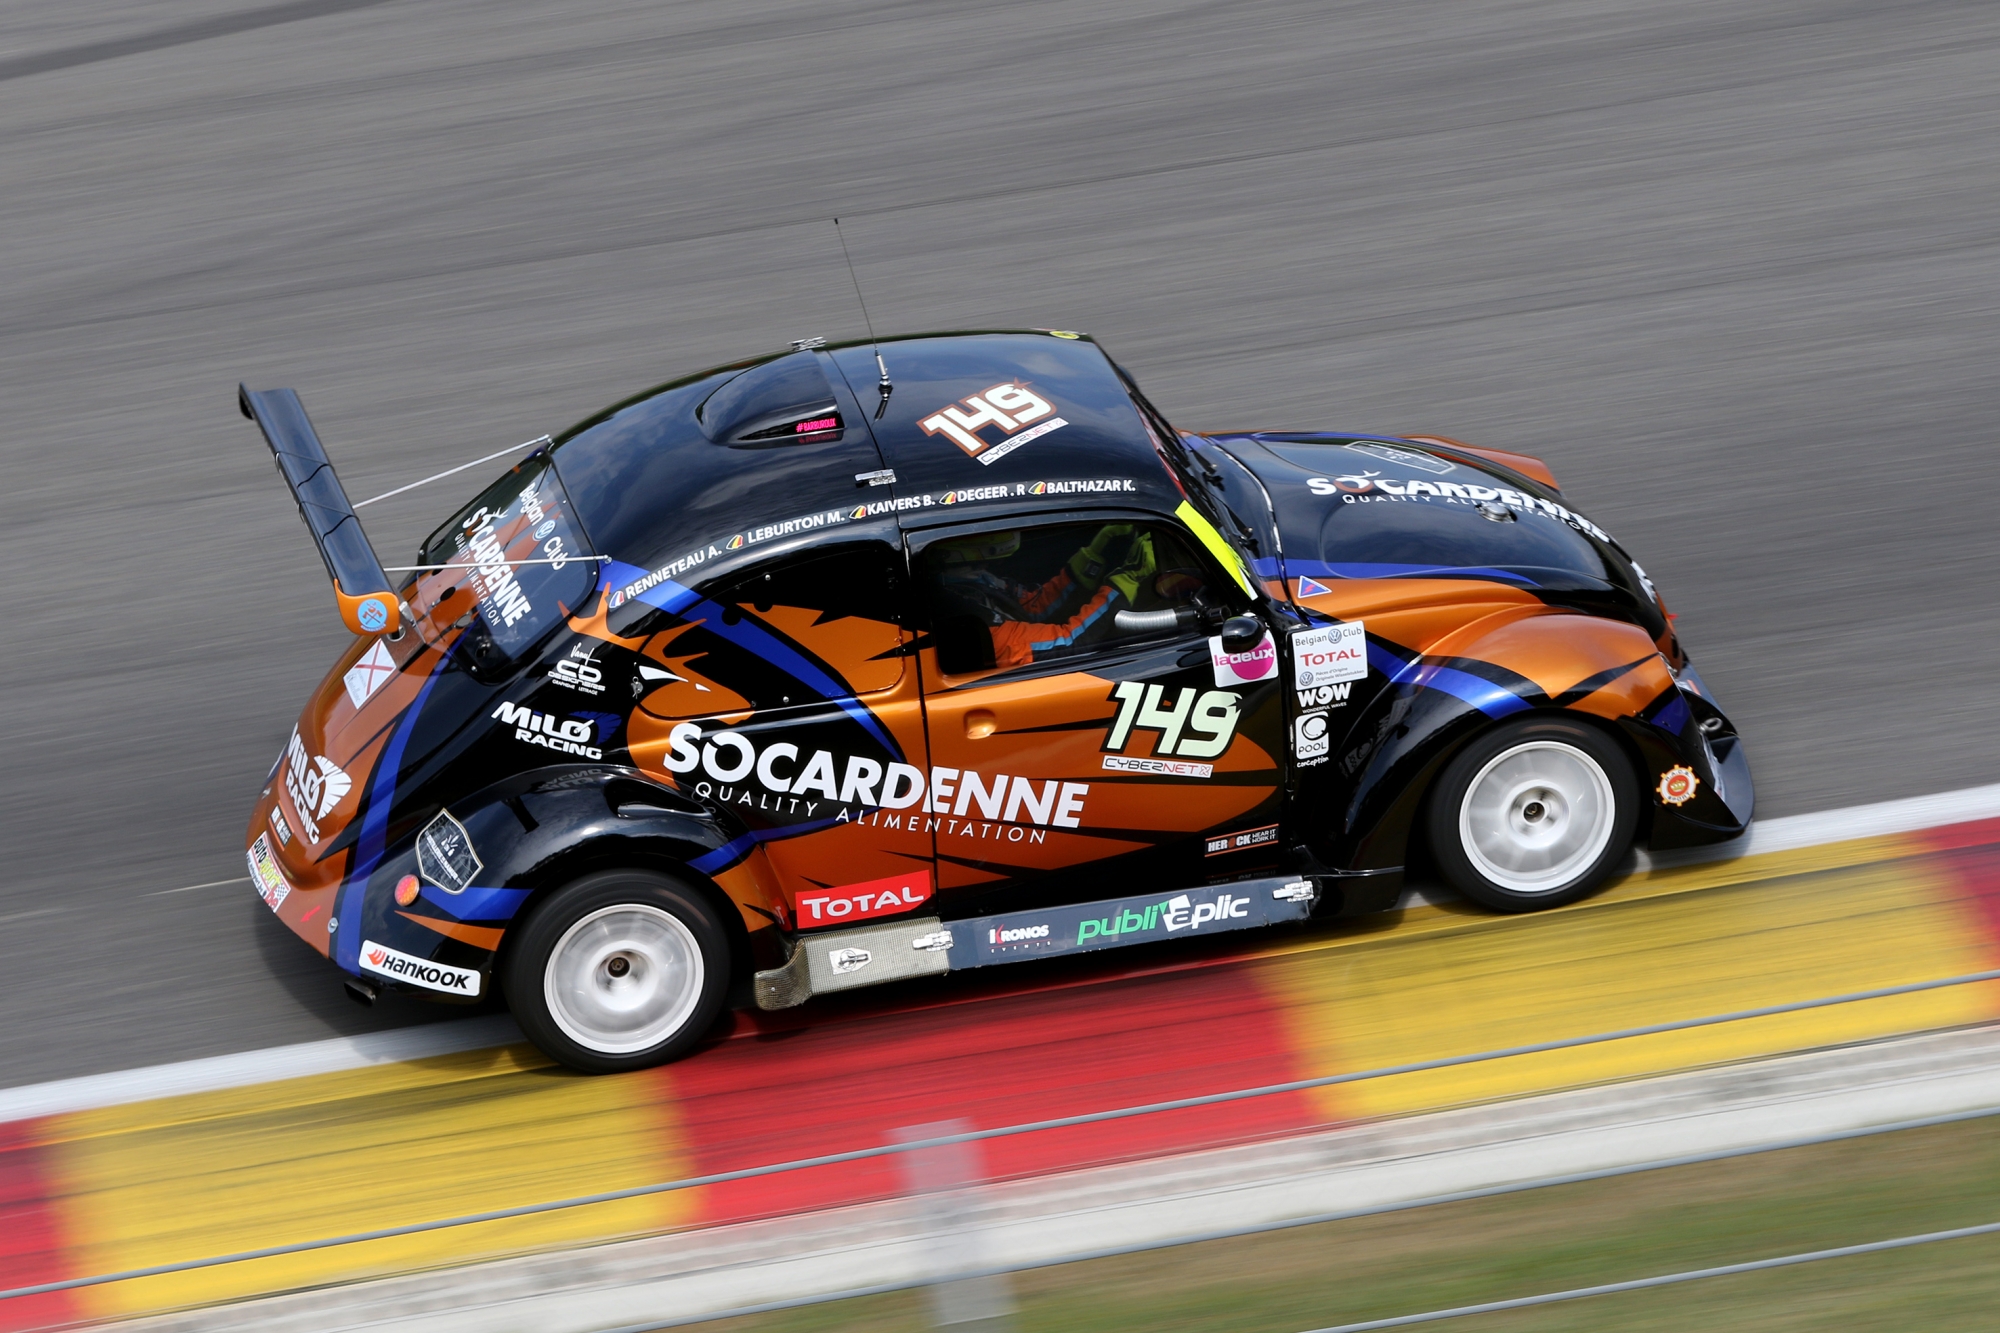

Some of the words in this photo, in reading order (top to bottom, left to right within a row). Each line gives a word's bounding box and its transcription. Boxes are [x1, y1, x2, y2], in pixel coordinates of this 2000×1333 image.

[920, 381, 1053, 453] 149
[1306, 474, 1610, 543] SOCARDENNE
[1342, 494, 1431, 504] QUALITY
[455, 532, 471, 562] QUALITY
[519, 482, 544, 527] Belgian
[543, 536, 569, 570] Club
[625, 550, 705, 599] RENNETEAU
[708, 545, 722, 559] A.
[747, 513, 824, 544] LEBURTON
[827, 510, 845, 523] M.
[866, 495, 921, 516] KAIVERS
[923, 494, 935, 507] B.
[957, 485, 1008, 502] DEGEER
[1047, 480, 1121, 494] BALTHAZAR
[1123, 480, 1136, 492] K.
[462, 506, 532, 627] SOCARDENNE
[1295, 635, 1327, 646] Belgian
[1343, 627, 1362, 638] Club
[1299, 648, 1361, 667] TOTAL
[1106, 680, 1243, 758] 149
[1297, 682, 1352, 707] WOW
[515, 728, 602, 760] RACING
[1299, 742, 1327, 754] POOL
[663, 722, 1089, 829] SOCARDENNE
[286, 768, 320, 845] RACING
[695, 781, 818, 817] QUALITY
[835, 807, 1046, 845] ALIMENTATION
[802, 886, 925, 920] TOTAL
[989, 924, 1050, 944] KRONOS
